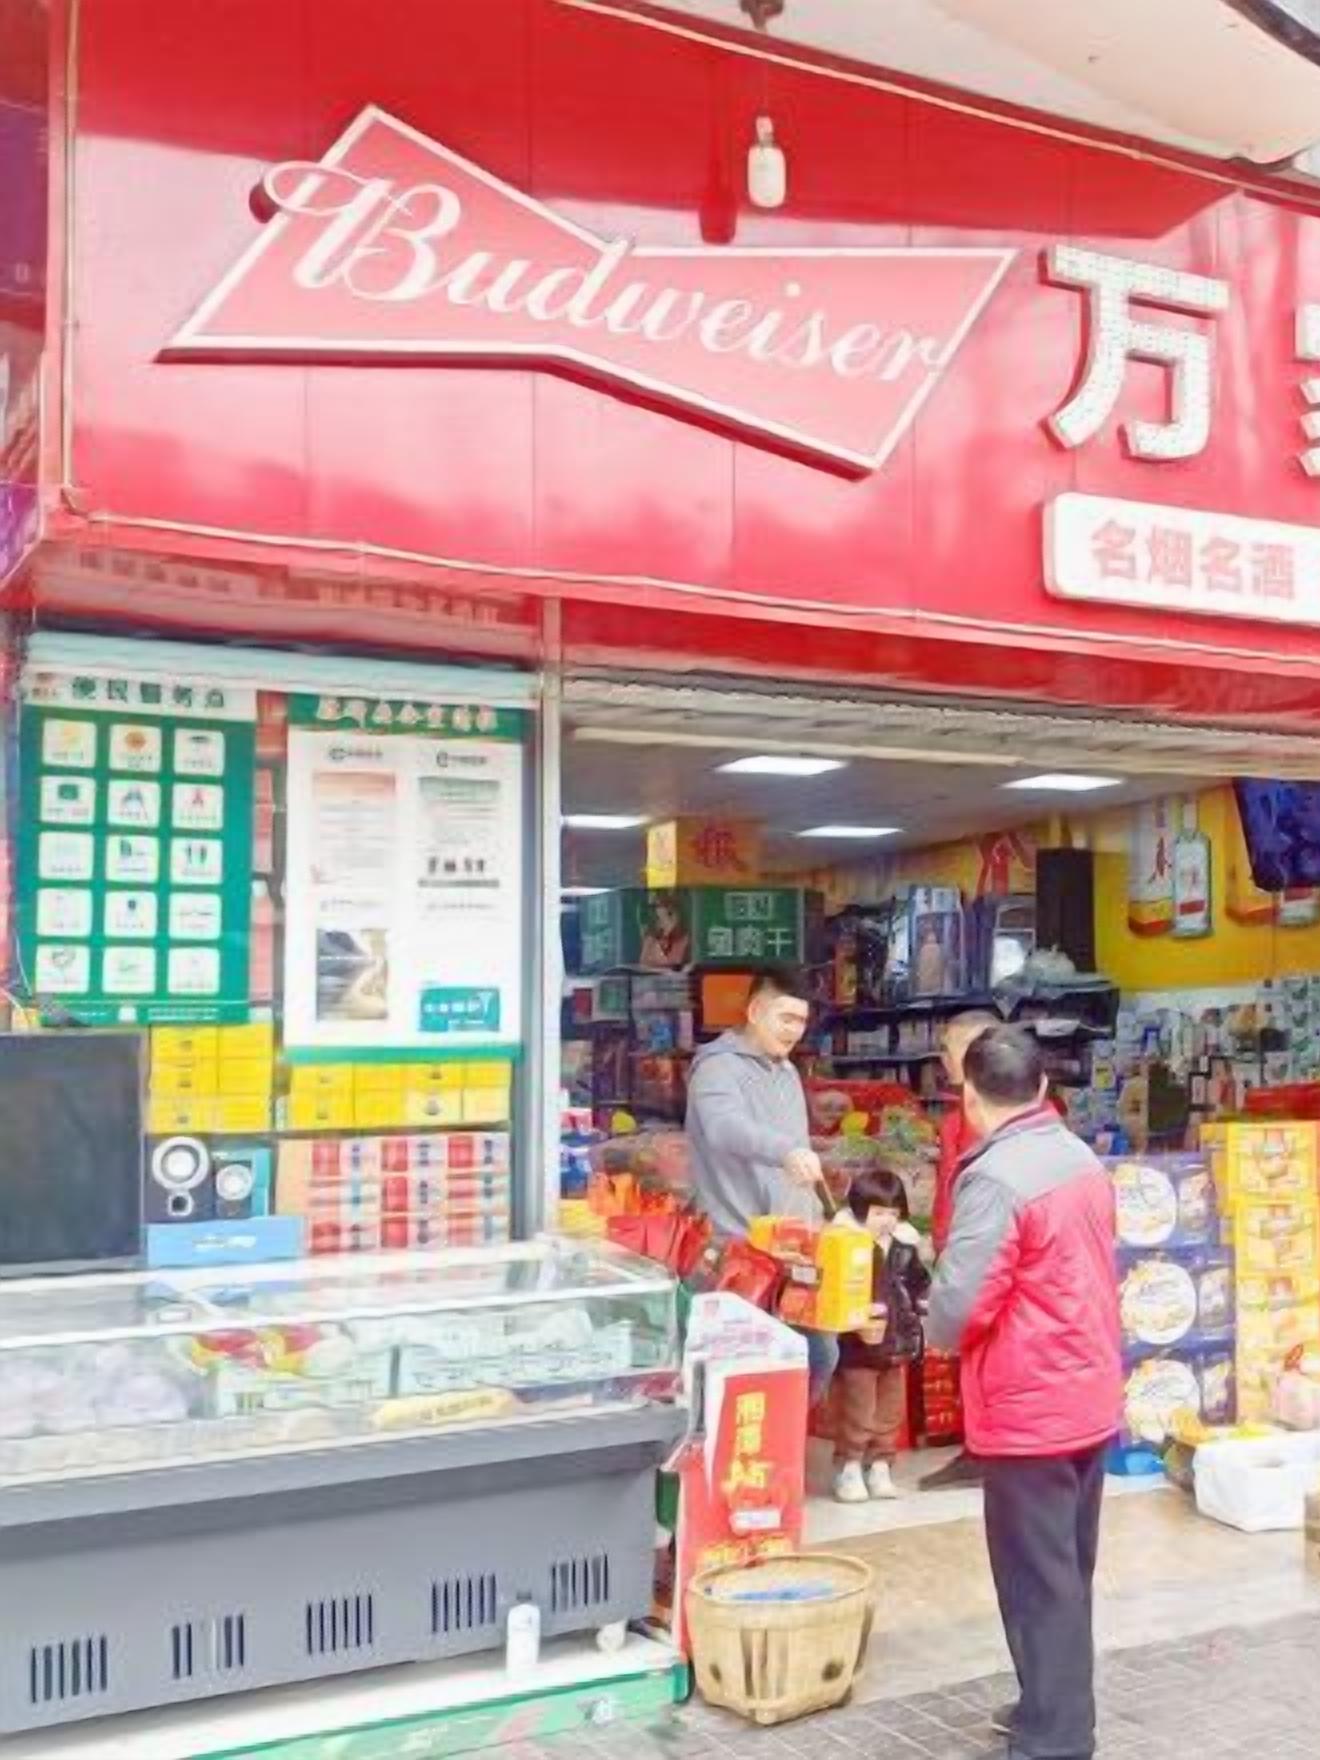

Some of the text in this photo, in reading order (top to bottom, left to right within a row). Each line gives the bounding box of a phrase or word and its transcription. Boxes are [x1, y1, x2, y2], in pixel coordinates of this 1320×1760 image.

[262, 158, 942, 386] Budweiser
[1090, 519, 1295, 602] 名烟名酒
